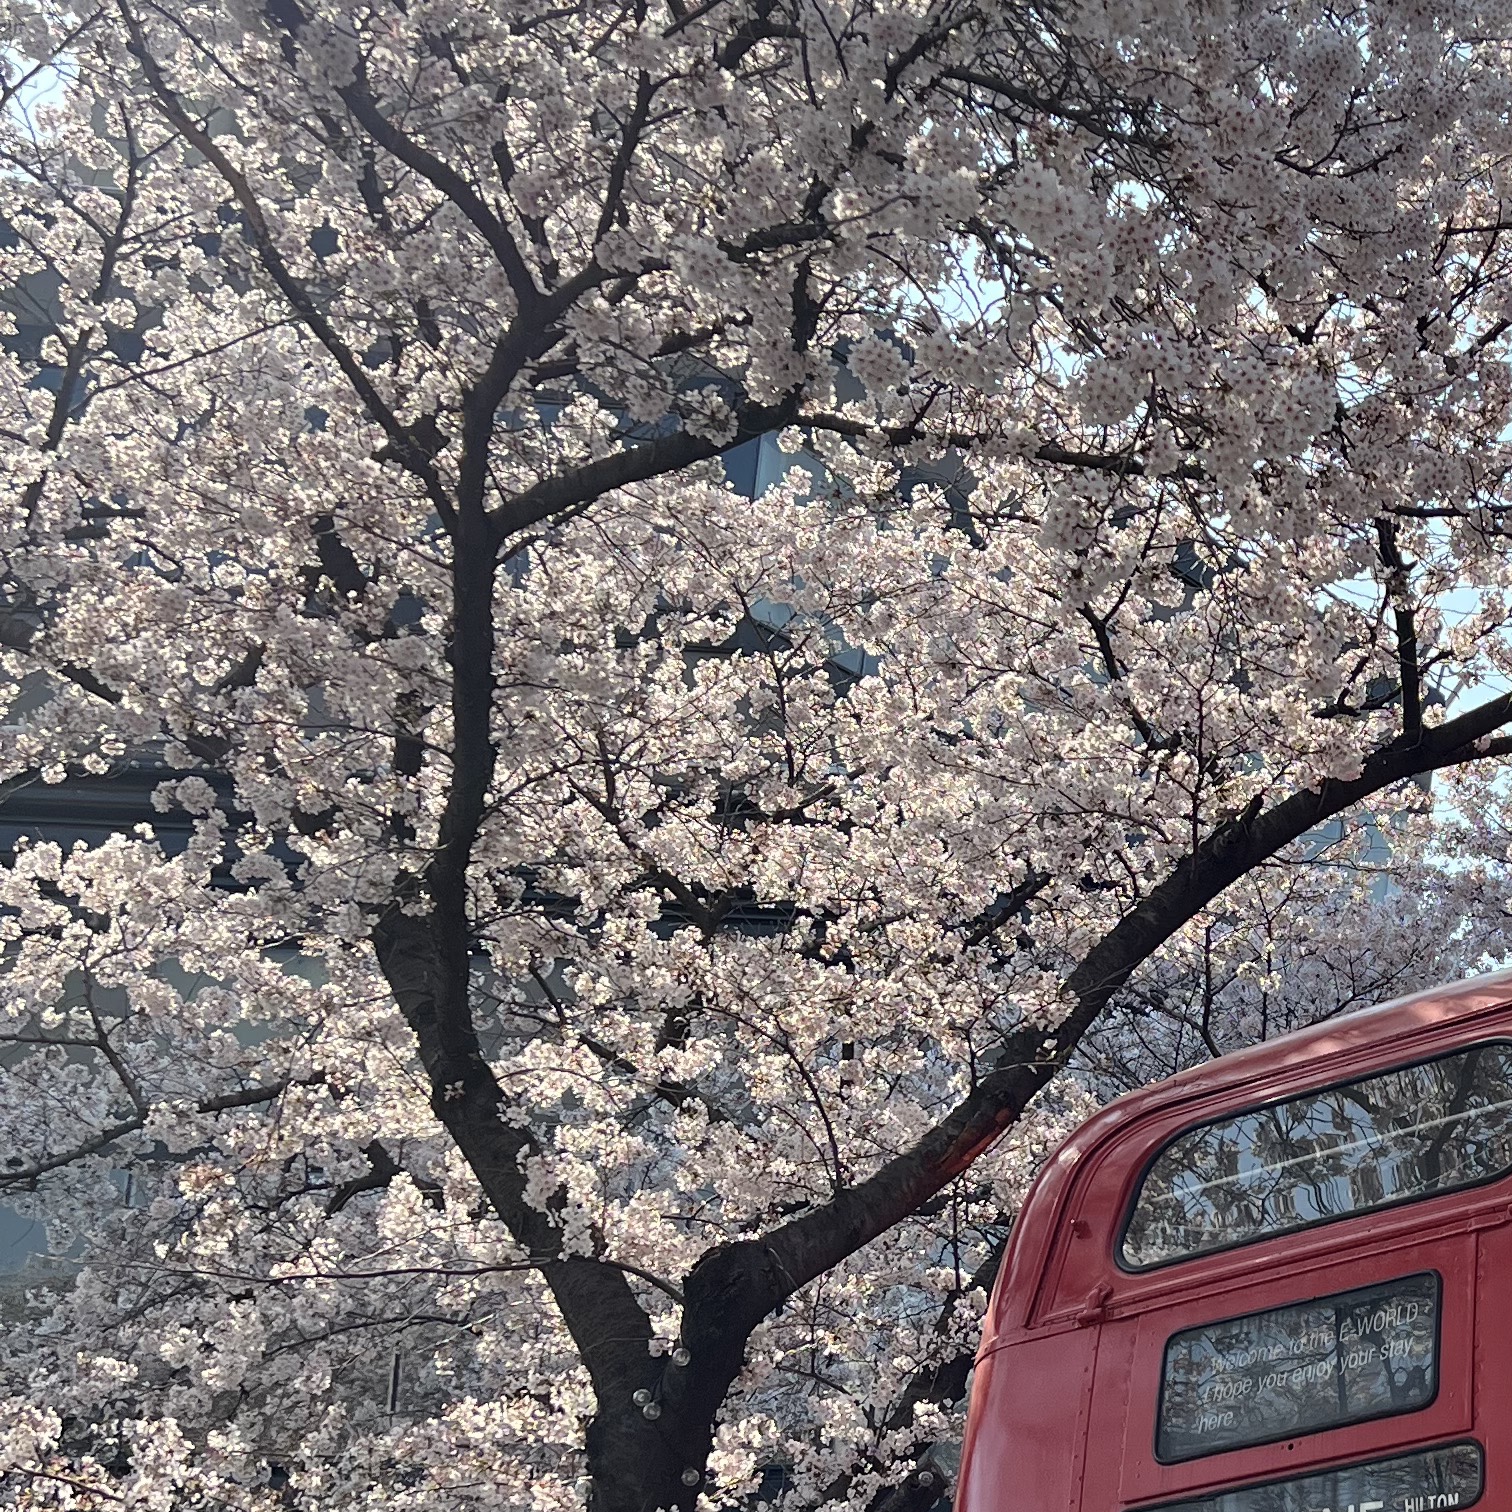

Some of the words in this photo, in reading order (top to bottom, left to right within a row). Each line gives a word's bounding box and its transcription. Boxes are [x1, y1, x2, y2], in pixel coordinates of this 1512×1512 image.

[1210, 1345, 1285, 1374] Welcome
[1288, 1339, 1304, 1353] to
[1308, 1328, 1336, 1348] the
[1339, 1302, 1419, 1343] E-WORLD
[1211, 1376, 1253, 1402] hope
[1257, 1371, 1287, 1394] you
[1292, 1359, 1337, 1383] enjoy
[1338, 1348, 1376, 1375] your
[1379, 1337, 1413, 1361] stay
